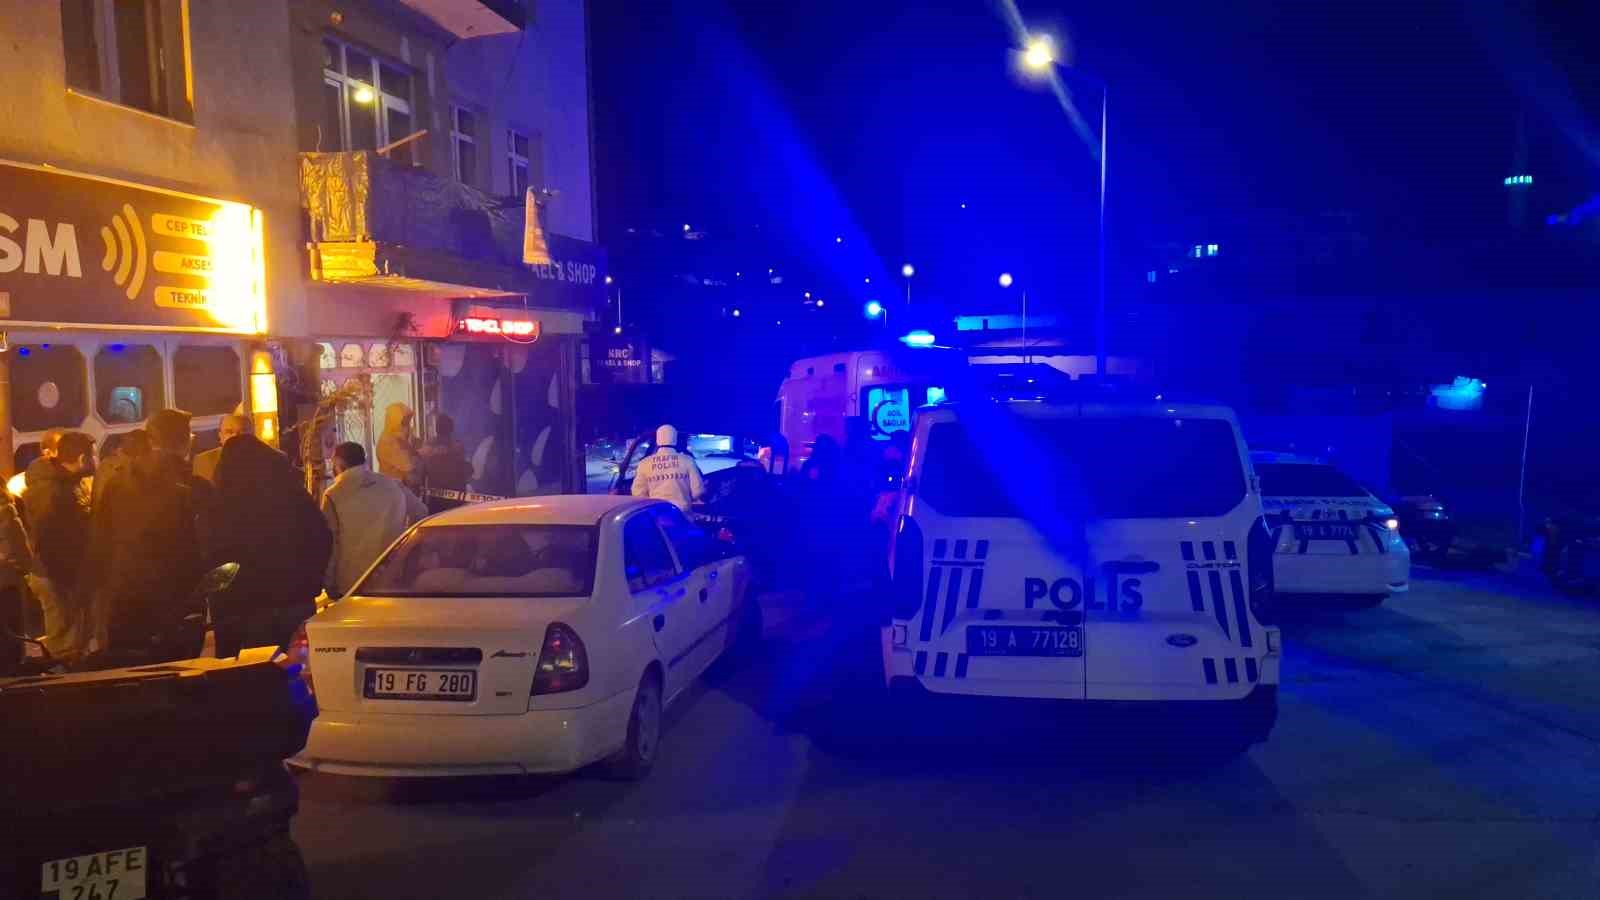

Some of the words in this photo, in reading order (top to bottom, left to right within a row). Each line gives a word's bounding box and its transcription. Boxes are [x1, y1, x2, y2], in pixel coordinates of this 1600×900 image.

[166, 220, 188, 233] CEP
[567, 261, 597, 284] SHOP
[980, 631, 997, 648] 19
[1008, 632, 1017, 648] A
[1032, 631, 1078, 649] 77128
[376, 673, 394, 691] 19
[406, 673, 427, 691] FG
[439, 674, 470, 692] 280
[50, 859, 79, 882] 19
[86, 849, 143, 878] AFE
